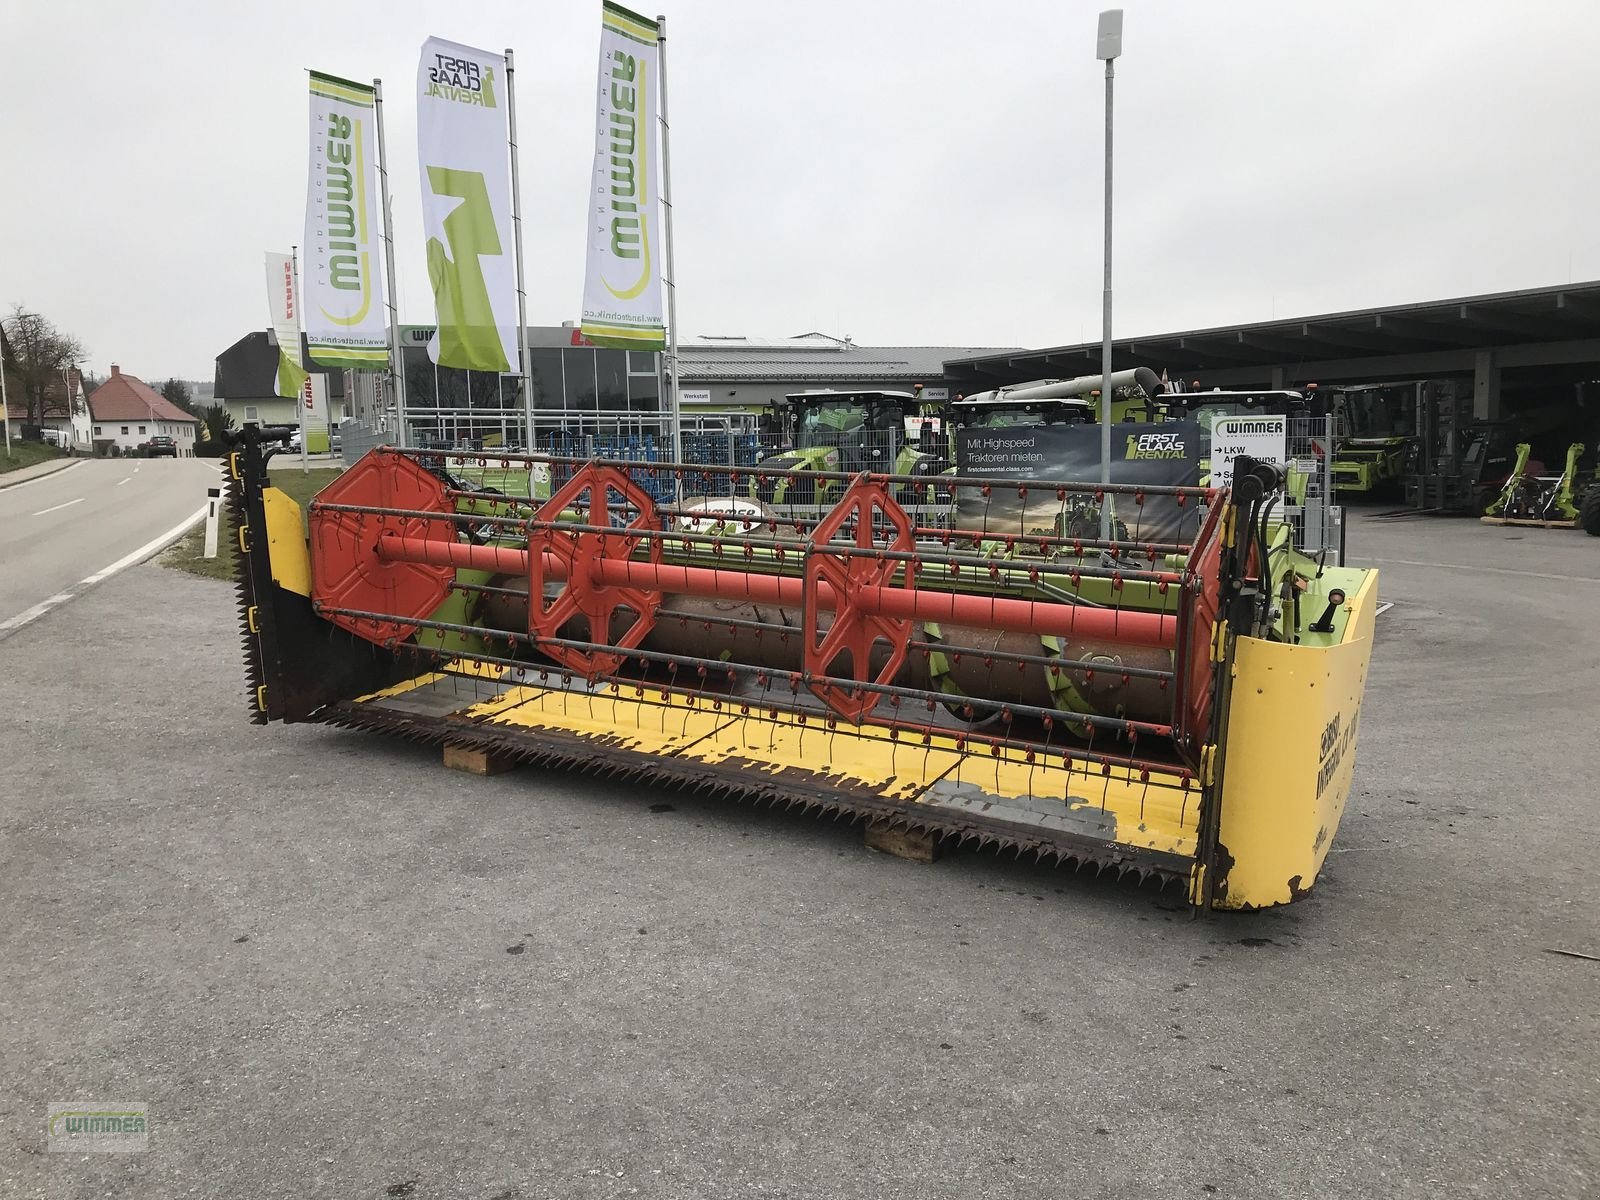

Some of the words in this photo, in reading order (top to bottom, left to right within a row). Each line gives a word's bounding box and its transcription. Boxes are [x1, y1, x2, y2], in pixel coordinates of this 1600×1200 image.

[1226, 422, 1283, 434] WIMMER
[1139, 433, 1180, 443] FIRST
[967, 438, 981, 449] Mit
[983, 437, 1035, 451] Highspeed
[1137, 441, 1185, 451] CLAAS
[1135, 450, 1188, 460] RENTAL
[1224, 446, 1246, 454] LKW
[967, 452, 1009, 463] Traktoren
[1010, 452, 1046, 462] mieten.
